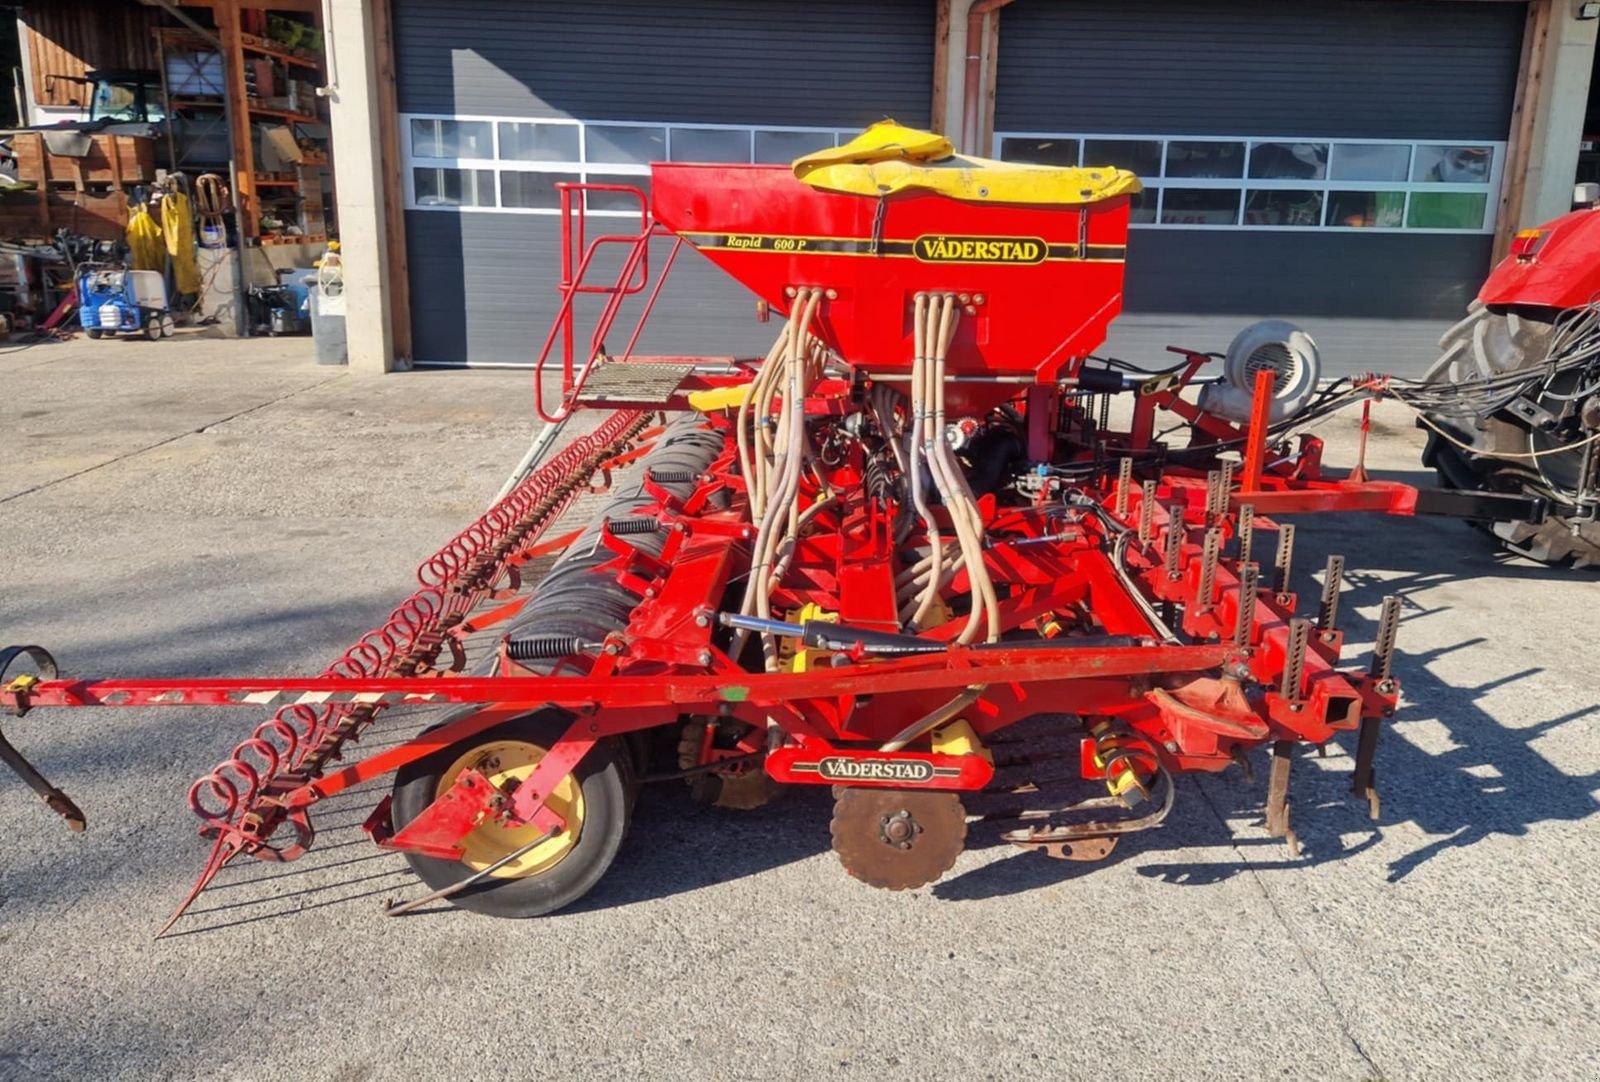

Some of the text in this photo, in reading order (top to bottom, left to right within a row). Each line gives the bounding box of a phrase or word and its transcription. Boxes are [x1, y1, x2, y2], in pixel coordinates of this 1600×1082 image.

[727, 235, 807, 250] Rapid 600 P
[923, 236, 1039, 260] VÄDERSTAD
[826, 759, 927, 779] VÄDERSTAD
